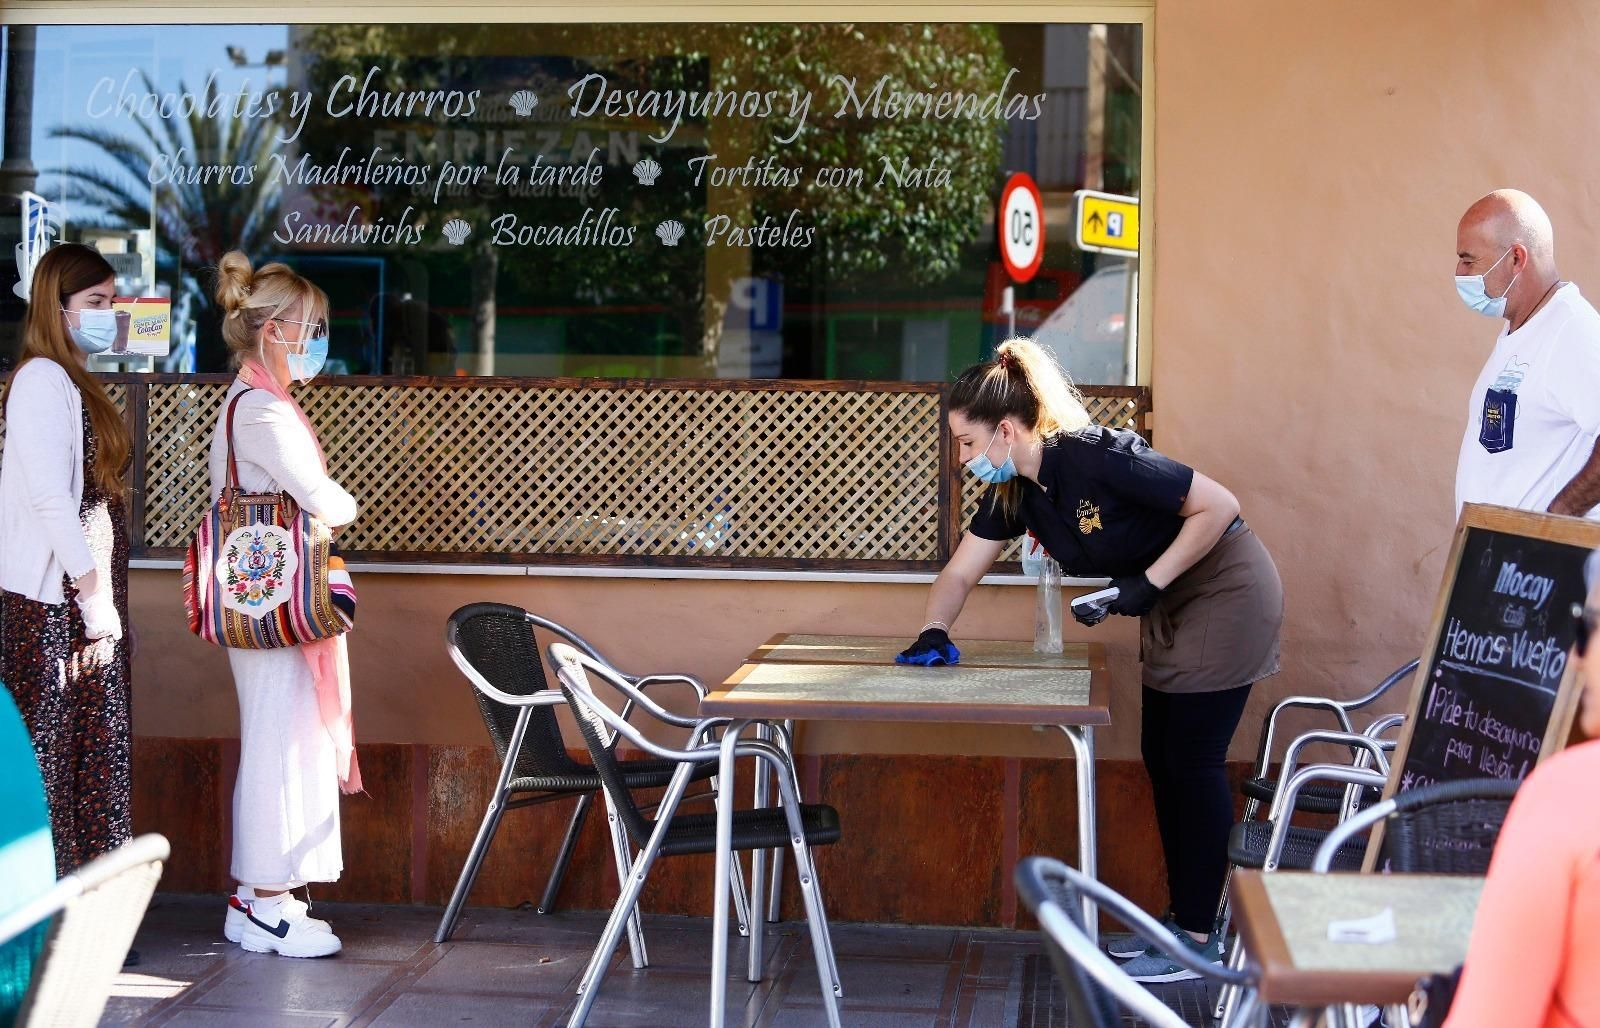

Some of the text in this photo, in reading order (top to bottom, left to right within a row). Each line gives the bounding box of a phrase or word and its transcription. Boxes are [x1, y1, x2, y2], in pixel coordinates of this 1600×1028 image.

[85, 66, 280, 120] Chocolates
[273, 85, 314, 144] y
[326, 66, 482, 119] Churros
[567, 67, 1048, 144] Desayunos y Meriendas
[147, 146, 604, 205] Churros Madrileños por la tarde
[687, 154, 953, 189] Tortitas con Nata
[272, 205, 816, 248] Sandwichs Bocadillos Pasteles
[1493, 561, 1554, 610] Mocay
[1443, 617, 1567, 681] Hemos Vuelto
[1443, 738, 1473, 767] para
[1463, 700, 1479, 730] tu
[1478, 709, 1541, 760] desayuno
